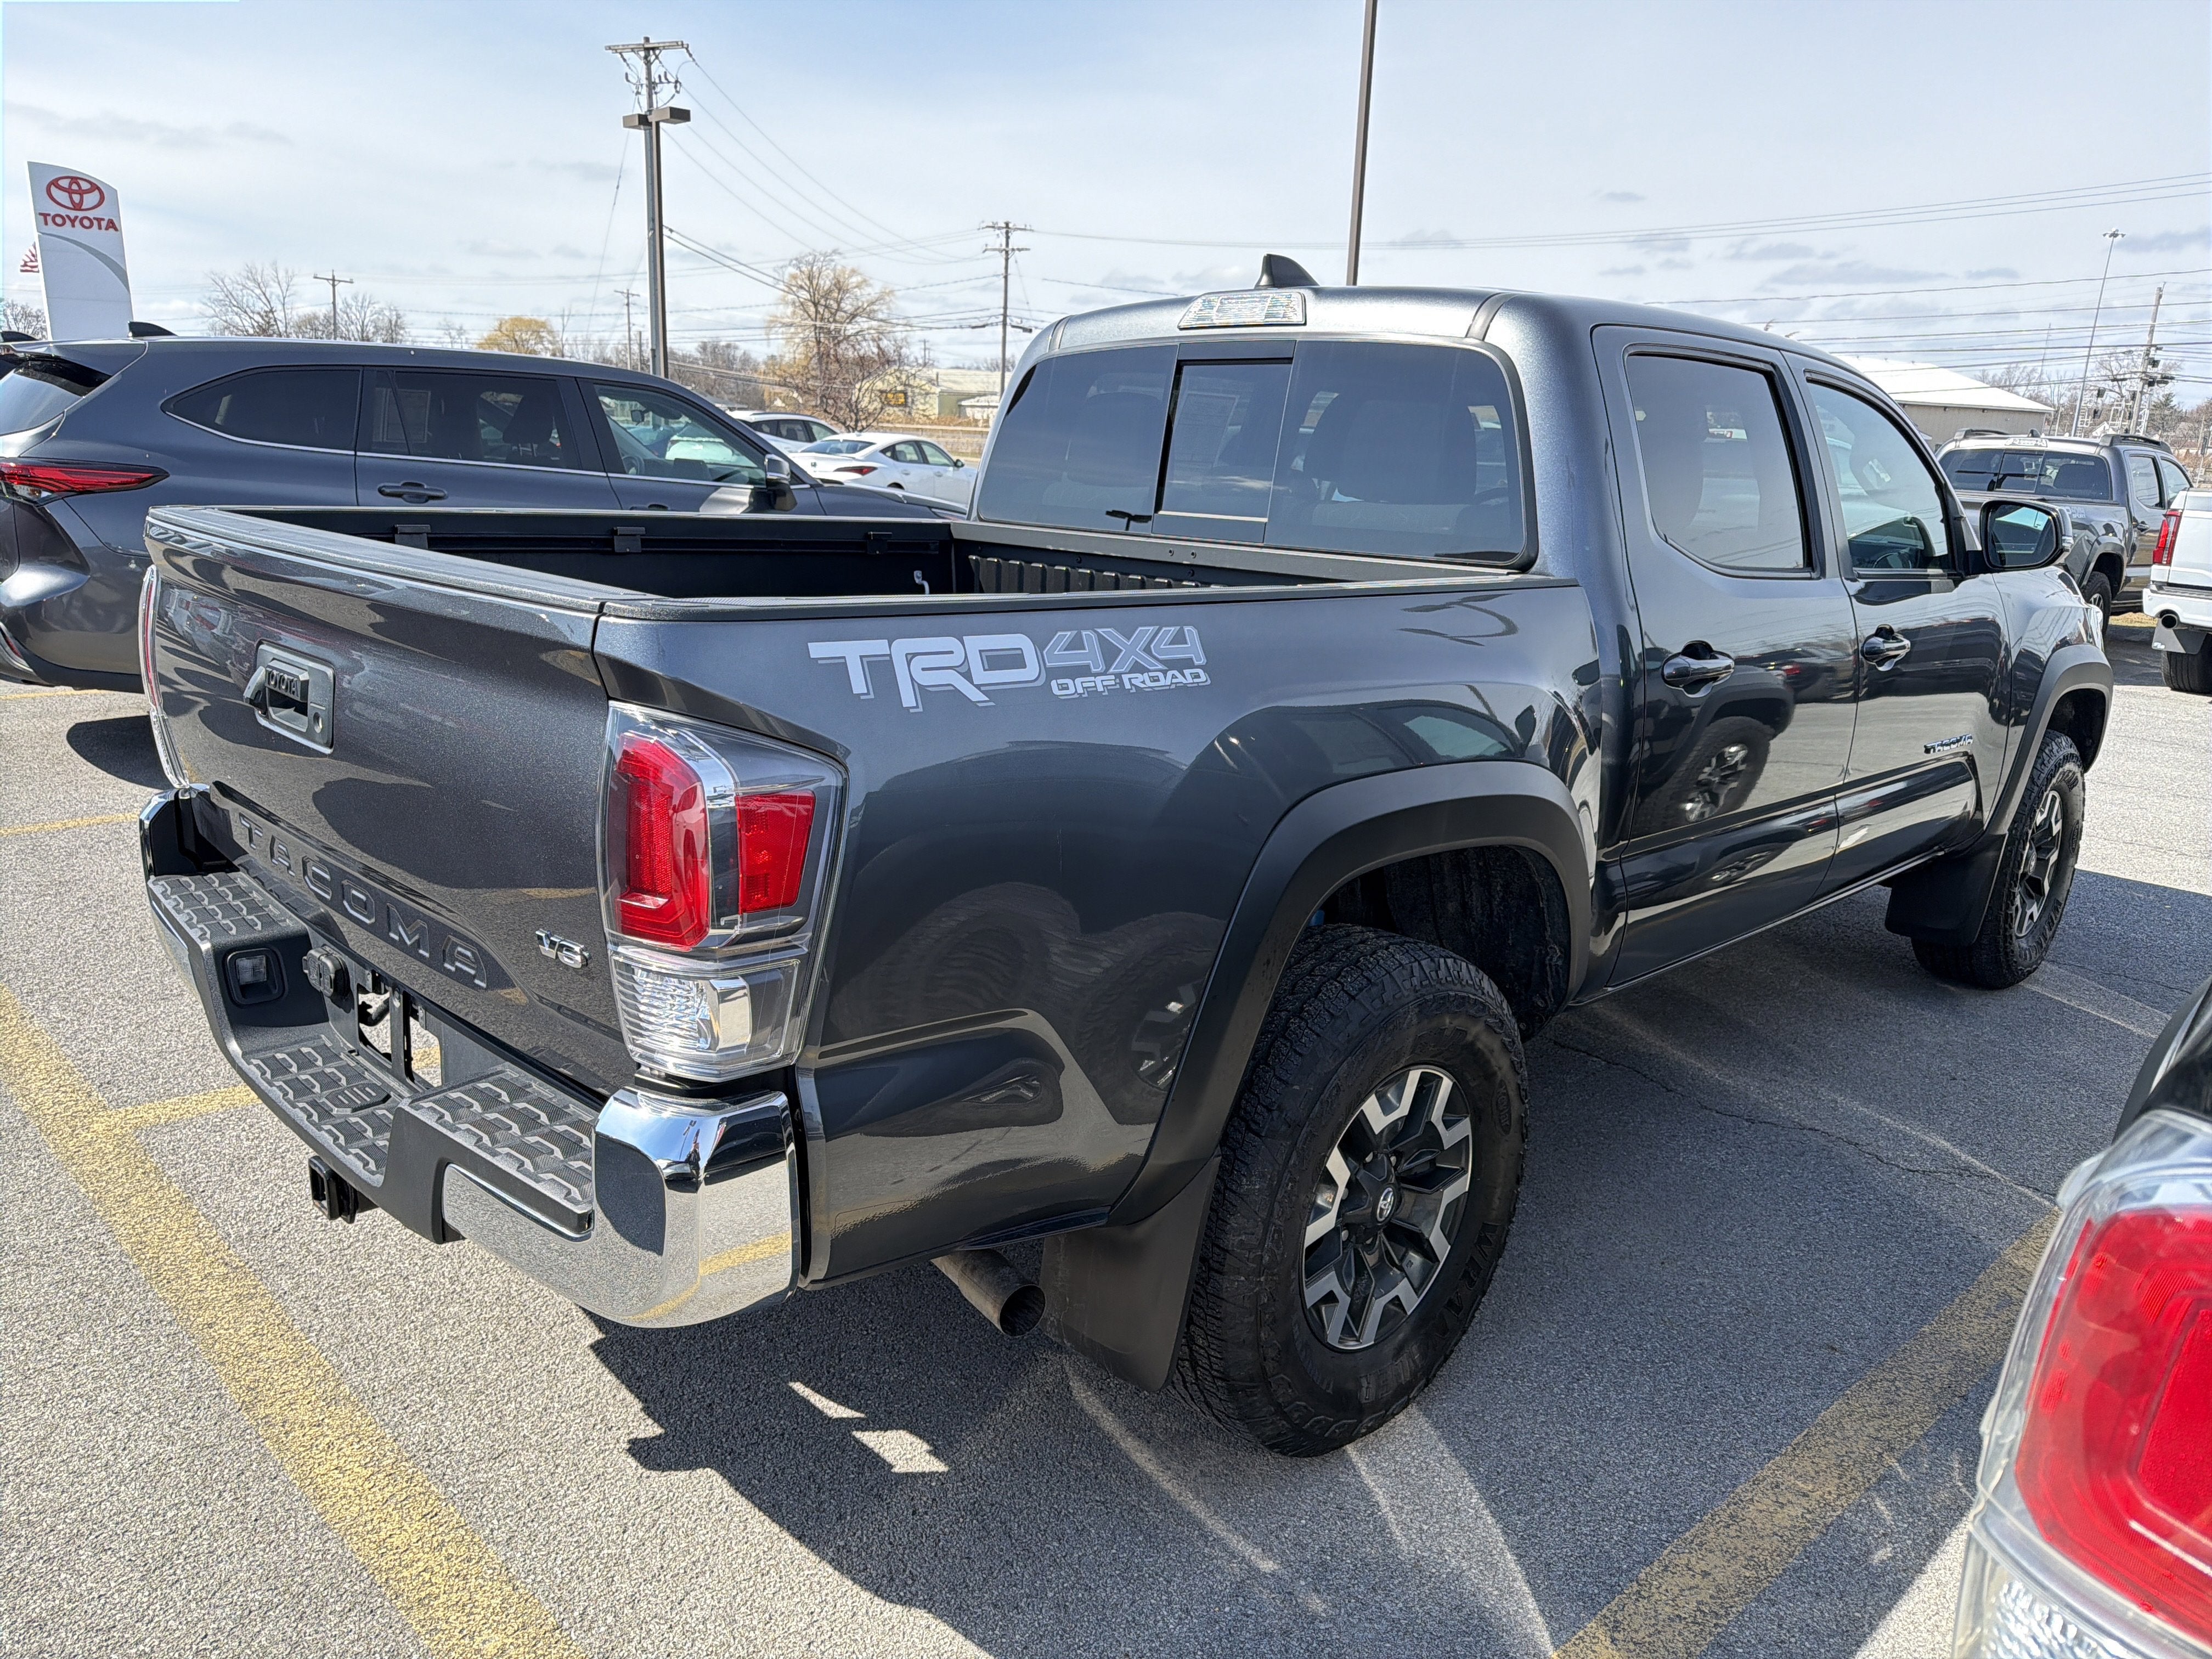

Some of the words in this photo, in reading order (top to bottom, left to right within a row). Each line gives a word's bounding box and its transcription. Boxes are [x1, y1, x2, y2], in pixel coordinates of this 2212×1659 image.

[38, 212, 119, 232] TOYOTA
[266, 668, 300, 697] TOYOTA
[808, 633, 1045, 712] TRD
[1044, 625, 1207, 673] 4X4
[1050, 672, 1119, 698] OFF
[1122, 668, 1211, 690] ROAD
[1924, 733, 1973, 754] TACOMA
[239, 812, 487, 989] TACOMA
[535, 928, 591, 969] V6
